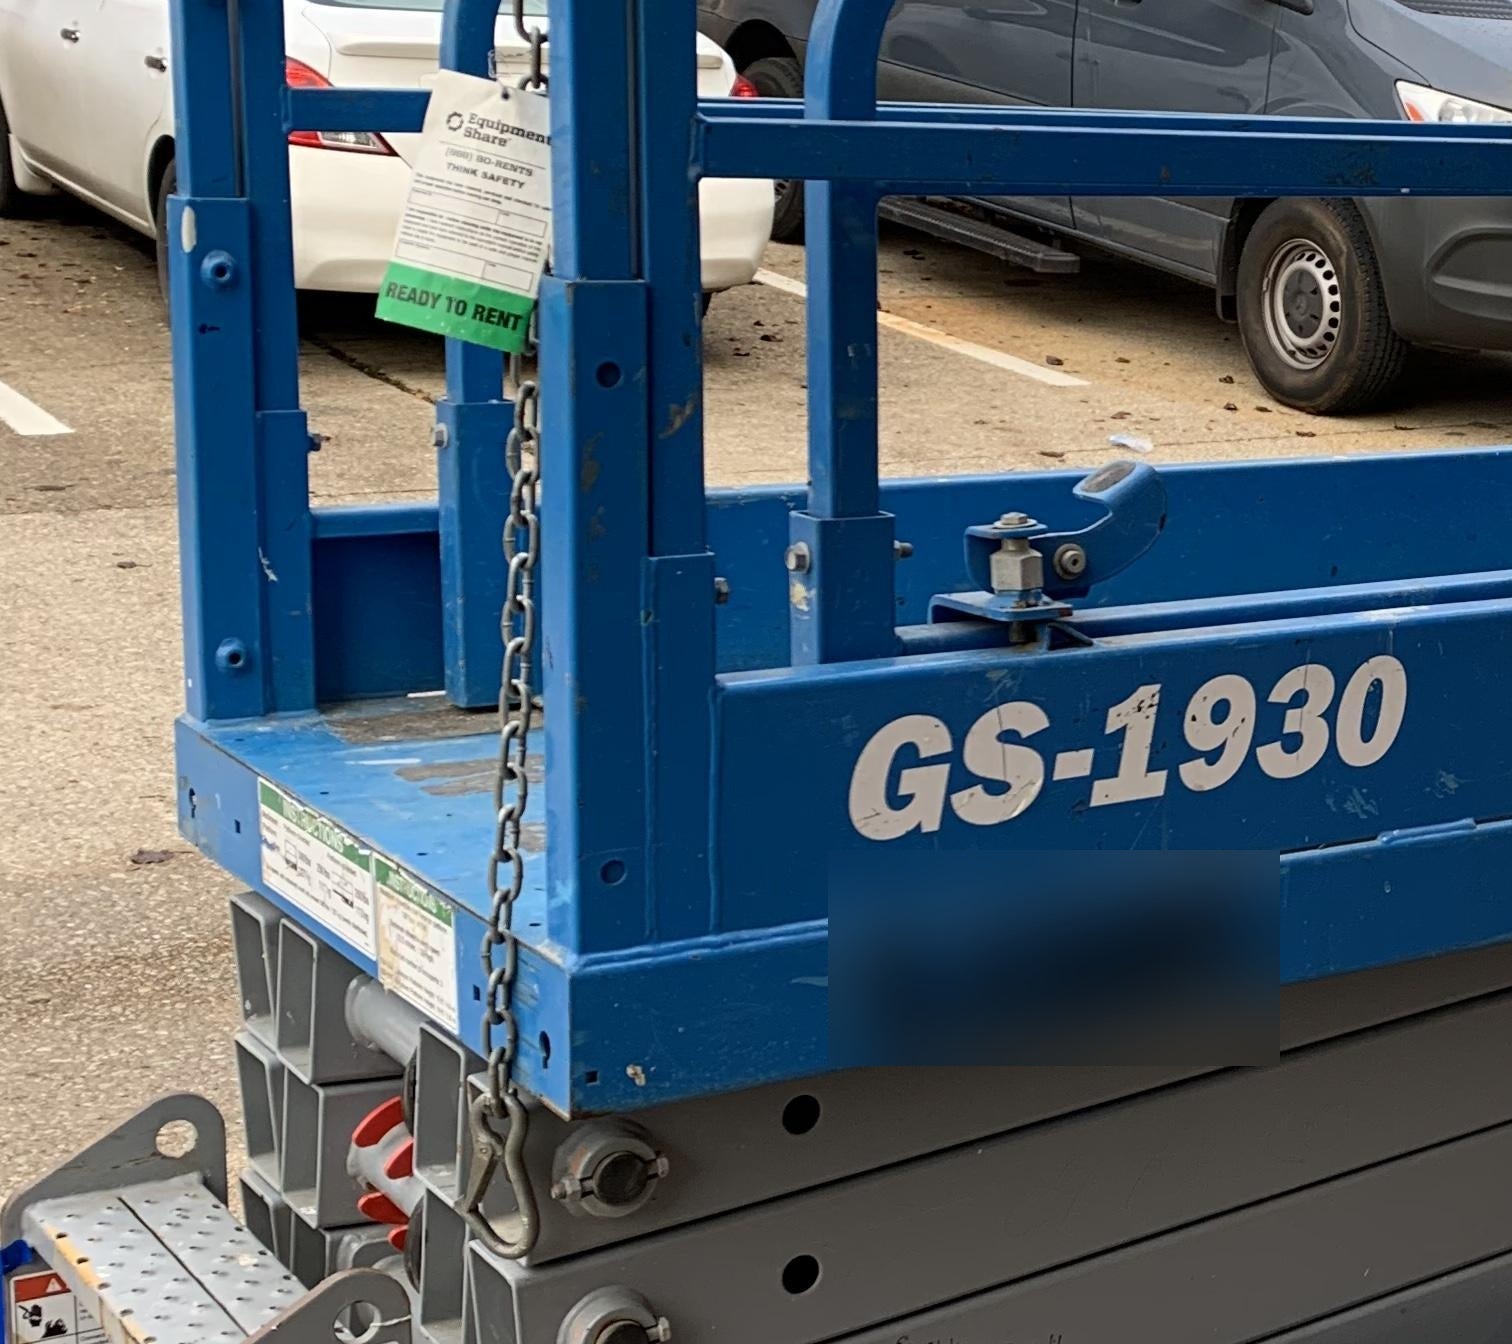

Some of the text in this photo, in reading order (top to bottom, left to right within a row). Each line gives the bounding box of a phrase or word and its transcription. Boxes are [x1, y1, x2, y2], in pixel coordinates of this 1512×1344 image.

[464, 126, 508, 147] Share
[468, 112, 552, 145] Equipment
[447, 162, 526, 189] THINK SAFETY
[384, 281, 524, 333] READY TO RENT
[849, 654, 1408, 842] GS-1930
